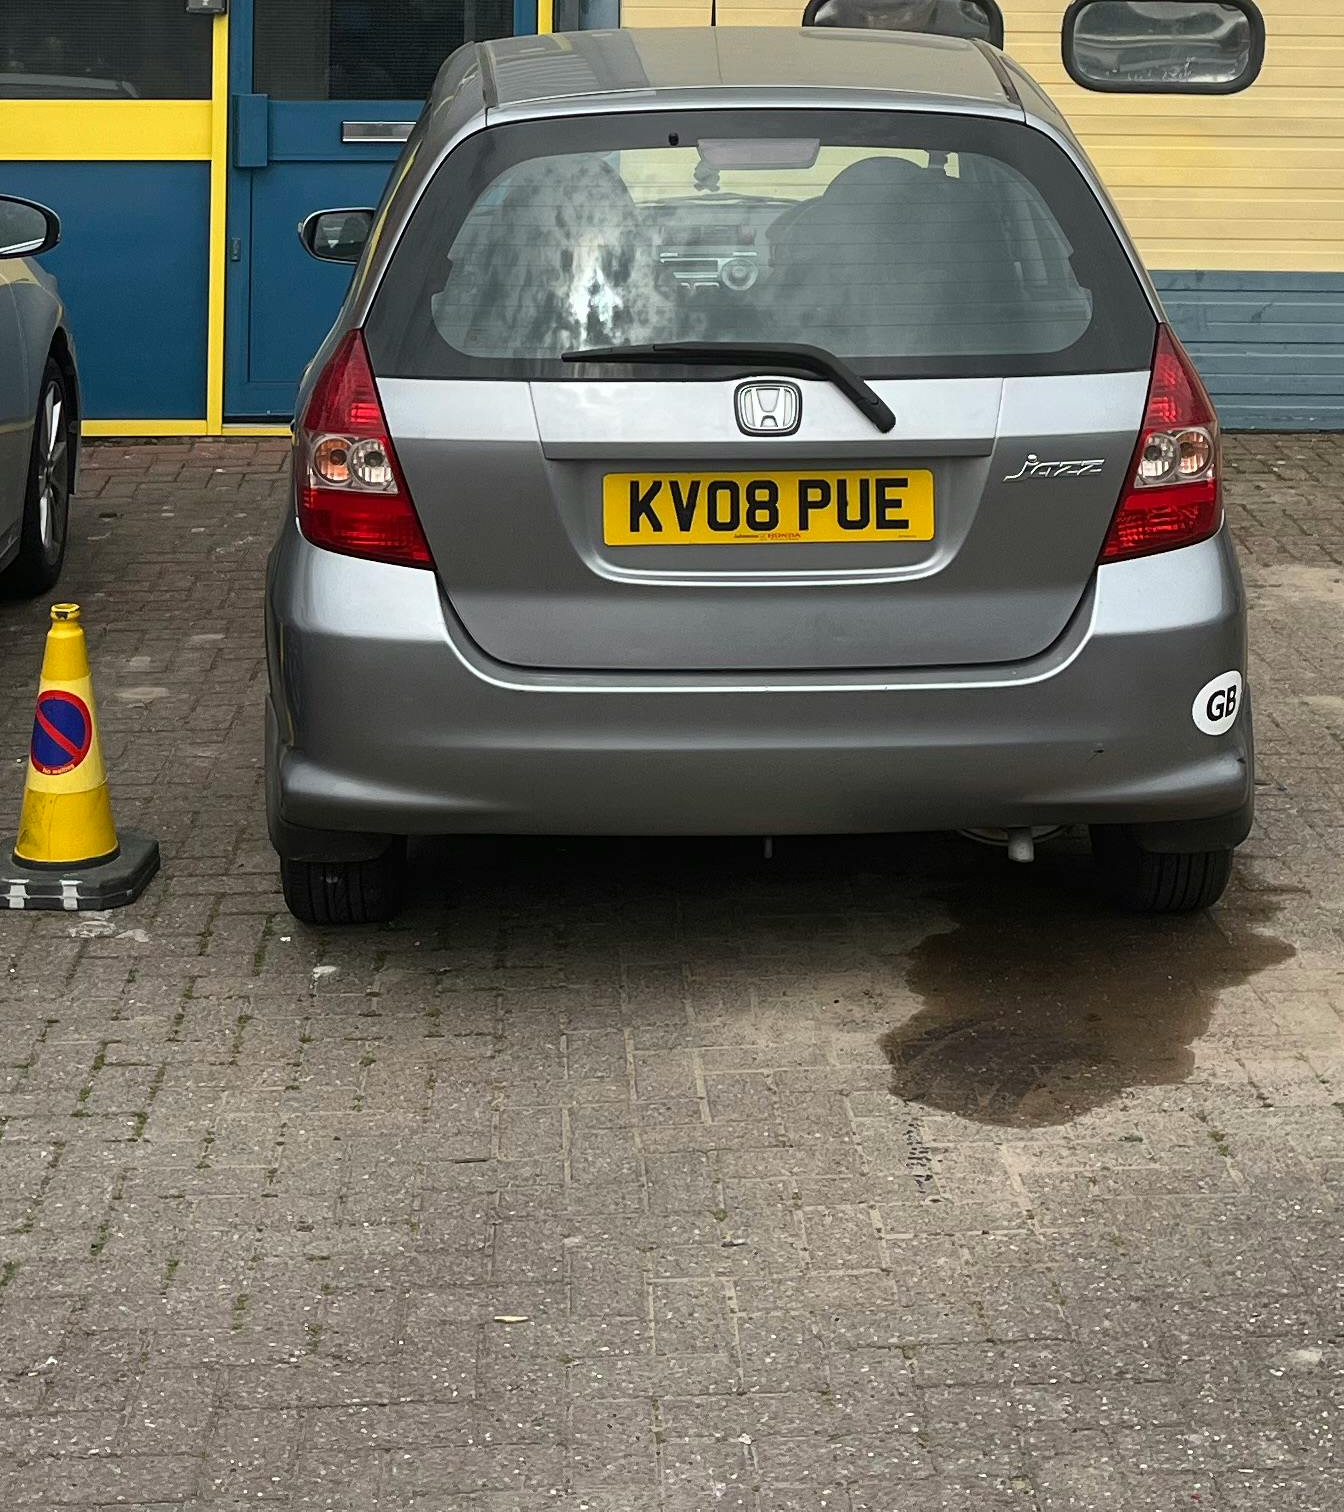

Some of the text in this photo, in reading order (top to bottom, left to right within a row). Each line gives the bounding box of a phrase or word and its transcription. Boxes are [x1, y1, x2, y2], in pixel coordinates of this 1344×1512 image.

[629, 477, 910, 533] KV08 PUE
[1206, 684, 1237, 722] GB
